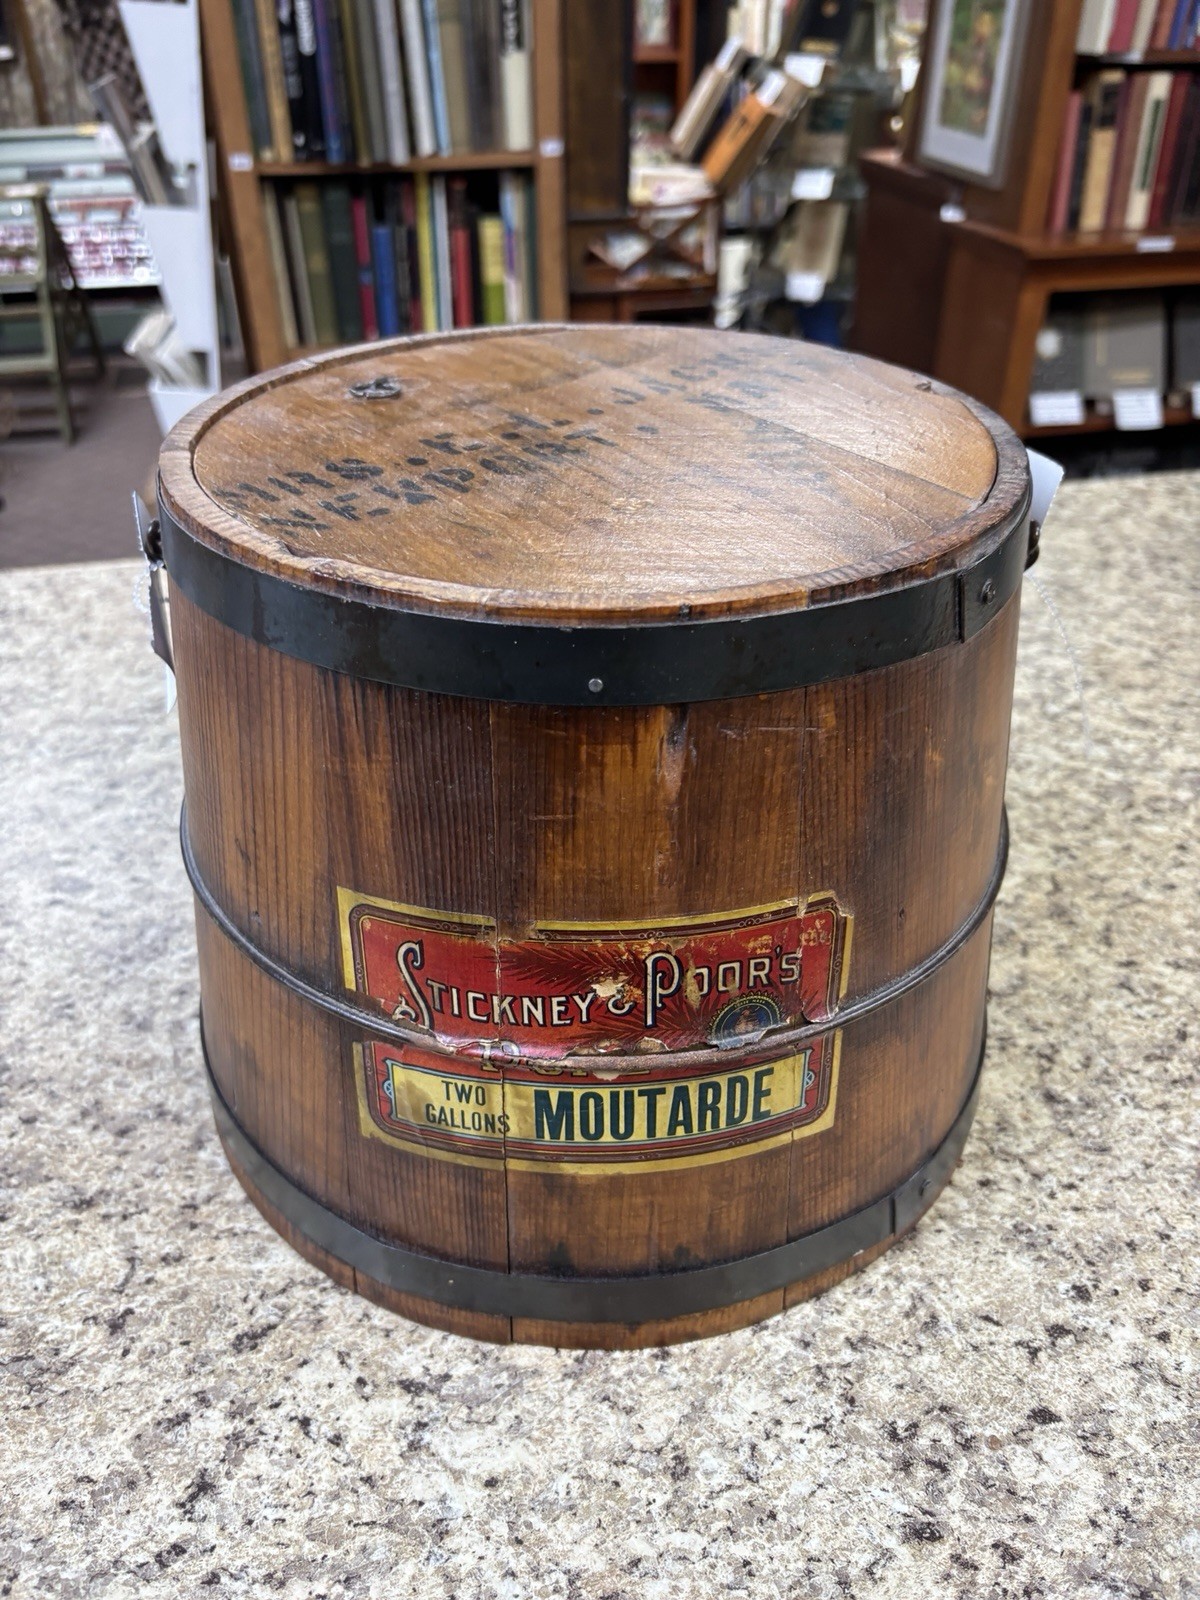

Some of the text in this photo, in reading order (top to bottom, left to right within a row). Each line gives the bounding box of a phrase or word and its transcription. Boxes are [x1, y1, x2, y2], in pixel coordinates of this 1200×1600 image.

[392, 939, 802, 1030] STICKNEY & POOR'S
[425, 1103, 511, 1136] GALLONS
[441, 1079, 486, 1107] TWO
[533, 1067, 775, 1142] MOUTARDE
